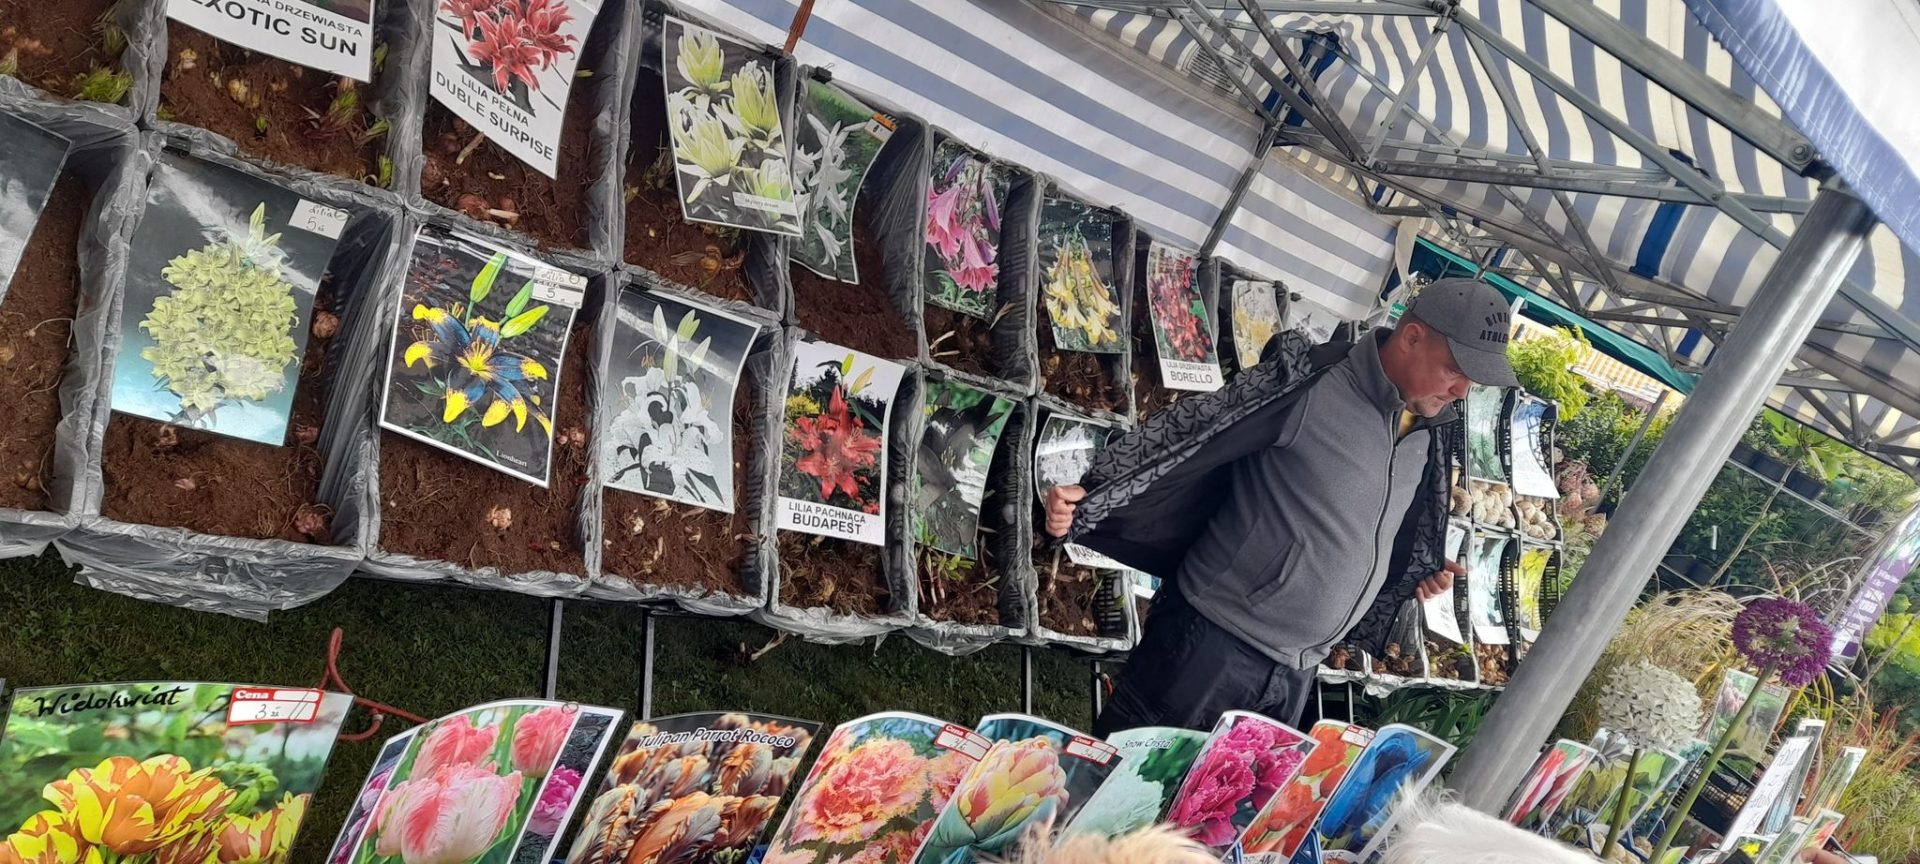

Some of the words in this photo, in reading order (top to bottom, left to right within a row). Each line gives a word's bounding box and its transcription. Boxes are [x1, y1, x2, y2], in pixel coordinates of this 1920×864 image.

[275, 1, 362, 37] DRZEWIASTA
[191, 0, 291, 36] XOTIC
[301, 27, 357, 57] SUN
[461, 74, 488, 101] LILIA
[492, 97, 529, 127] PEŁNA
[436, 72, 486, 117] DUBLE
[489, 112, 553, 161] SURPISE
[546, 288, 556, 298] 5
[1171, 371, 1213, 384] BORELLO
[496, 450, 528, 467] Lionheart
[788, 502, 813, 514] LILIA
[793, 513, 862, 535] BUDAPEST
[33, 685, 190, 718] Widokwiat
[235, 690, 270, 700] Cena
[255, 703, 267, 720] 3
[638, 732, 691, 748] Tulipan
[691, 728, 740, 743] Parrot
[740, 728, 796, 748] Rococo
[945, 724, 965, 737] Cena
[1122, 740, 1145, 749] Snow
